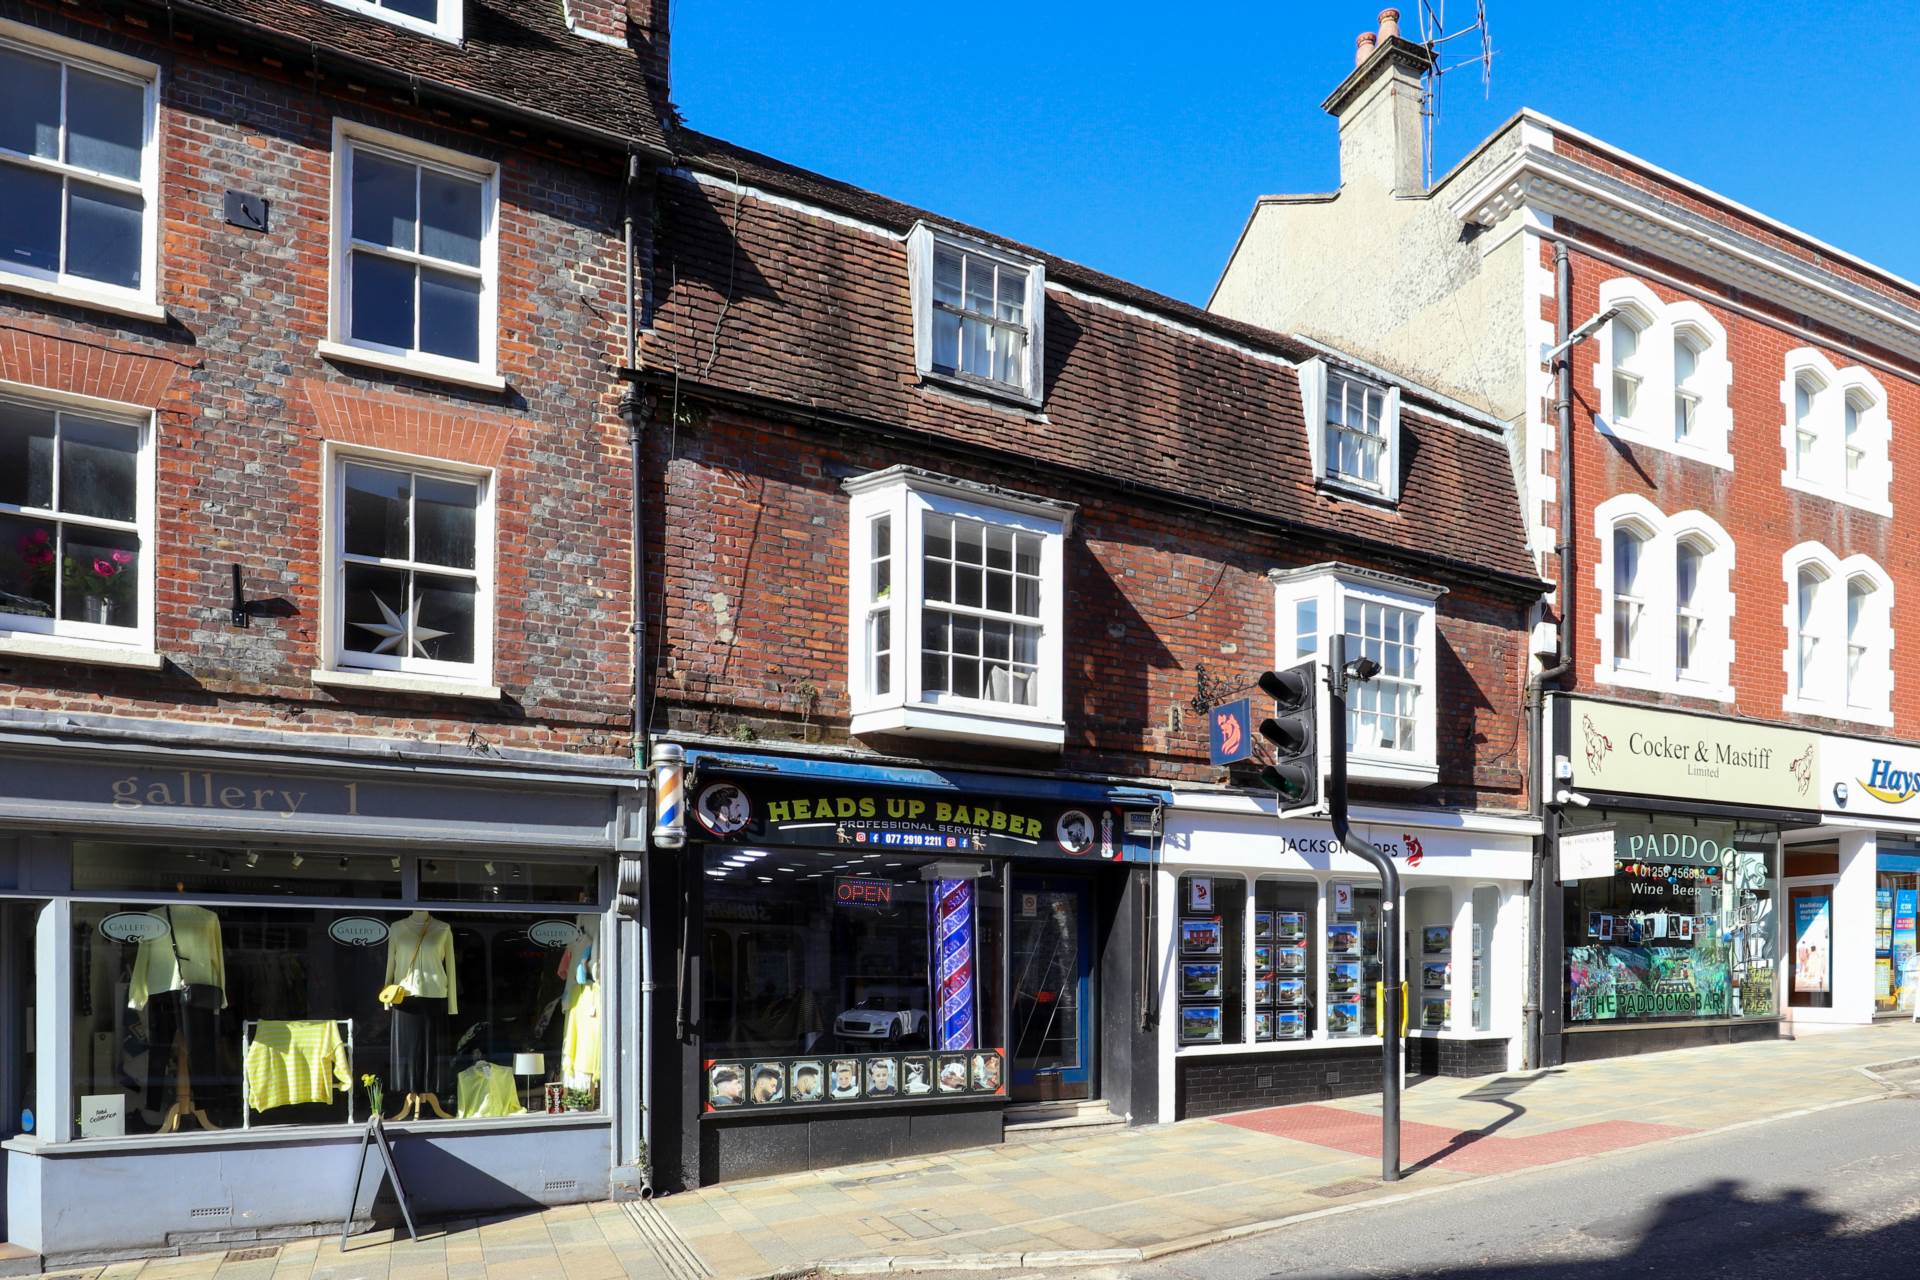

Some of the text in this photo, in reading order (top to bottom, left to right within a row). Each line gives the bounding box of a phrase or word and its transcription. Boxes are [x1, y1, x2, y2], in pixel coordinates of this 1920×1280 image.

[1629, 732, 1773, 770] Cocker & Mastiff
[1687, 764, 1720, 779] Limited
[111, 768, 361, 819] gallery 1
[767, 797, 1043, 839] HEADS UP BARBER
[839, 820, 988, 838] PROFESSIONAL SERVICE
[885, 833, 901, 845] 077
[903, 834, 923, 846] 2910
[924, 836, 942, 847] 2211
[1280, 837, 1349, 855] JACKSON
[1630, 833, 1768, 887] PADDOCKS
[838, 884, 891, 903] OPEN
[1630, 882, 1664, 895] Wine
[1672, 884, 1702, 896] Beer
[1587, 994, 1616, 1013] THE
[1617, 992, 1692, 1013] PADDOCKS
